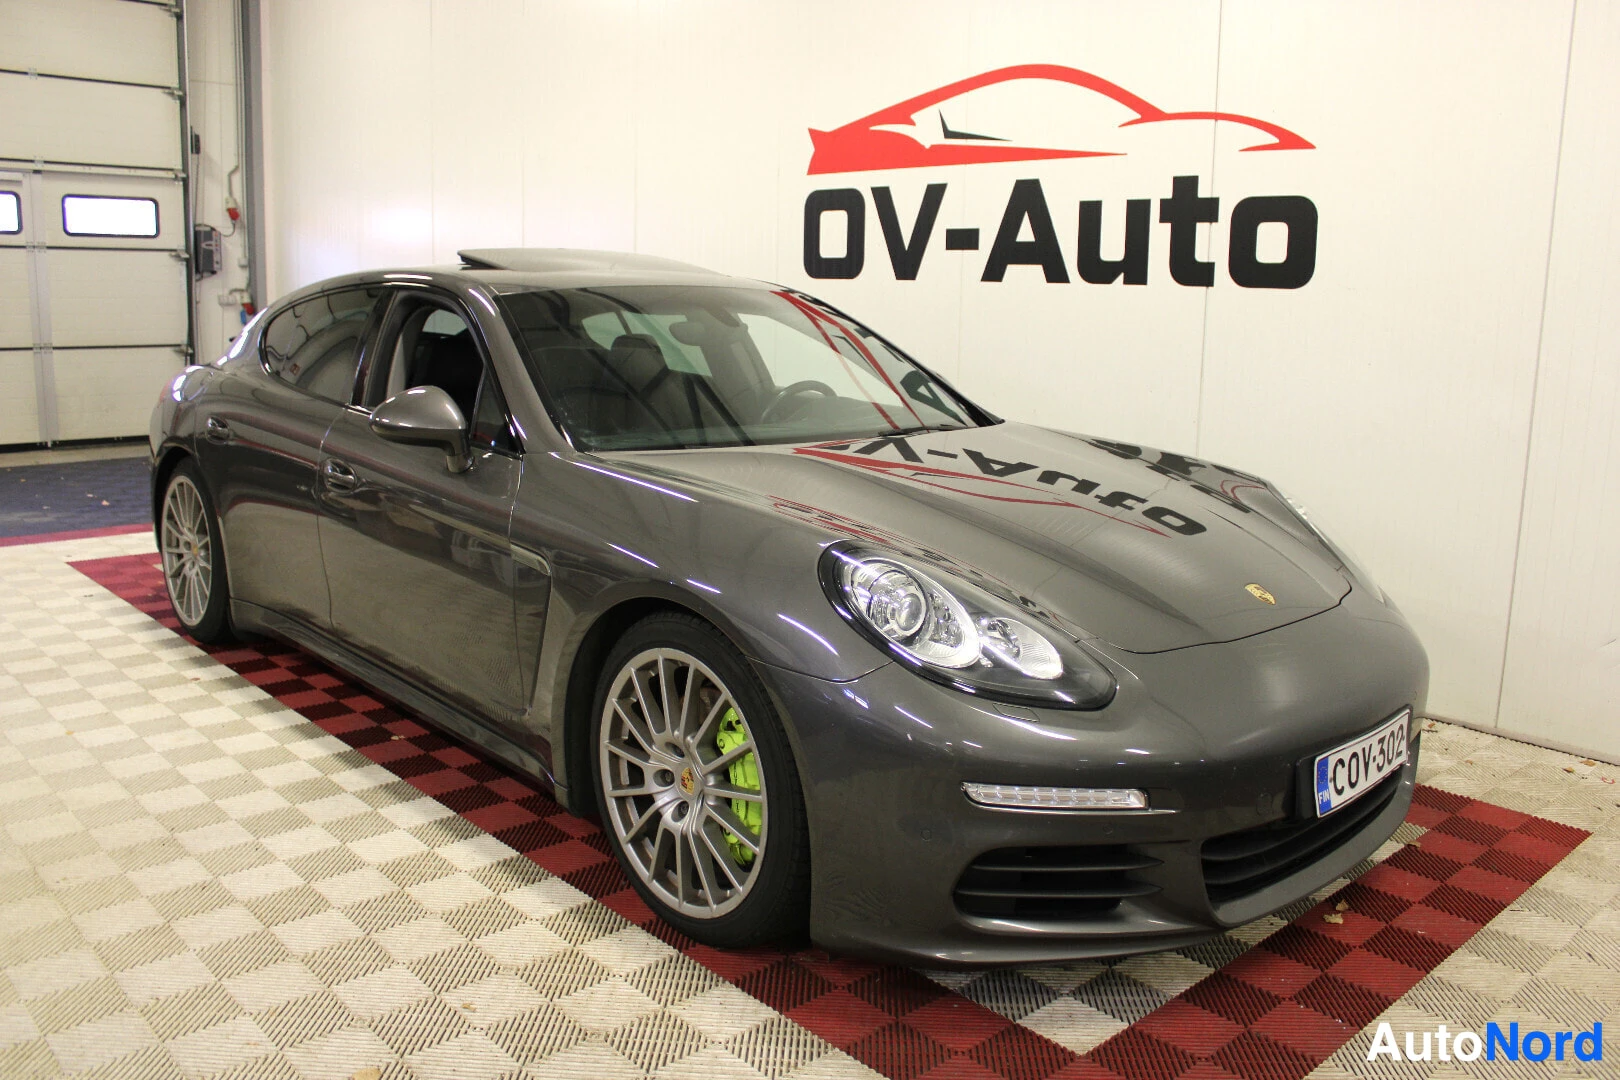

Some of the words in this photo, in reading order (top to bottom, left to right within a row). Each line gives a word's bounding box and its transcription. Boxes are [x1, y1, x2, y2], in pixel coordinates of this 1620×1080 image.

[803, 175, 1318, 289] OV-Auto
[1333, 723, 1405, 796] COV-302
[1318, 788, 1331, 805] FIN
